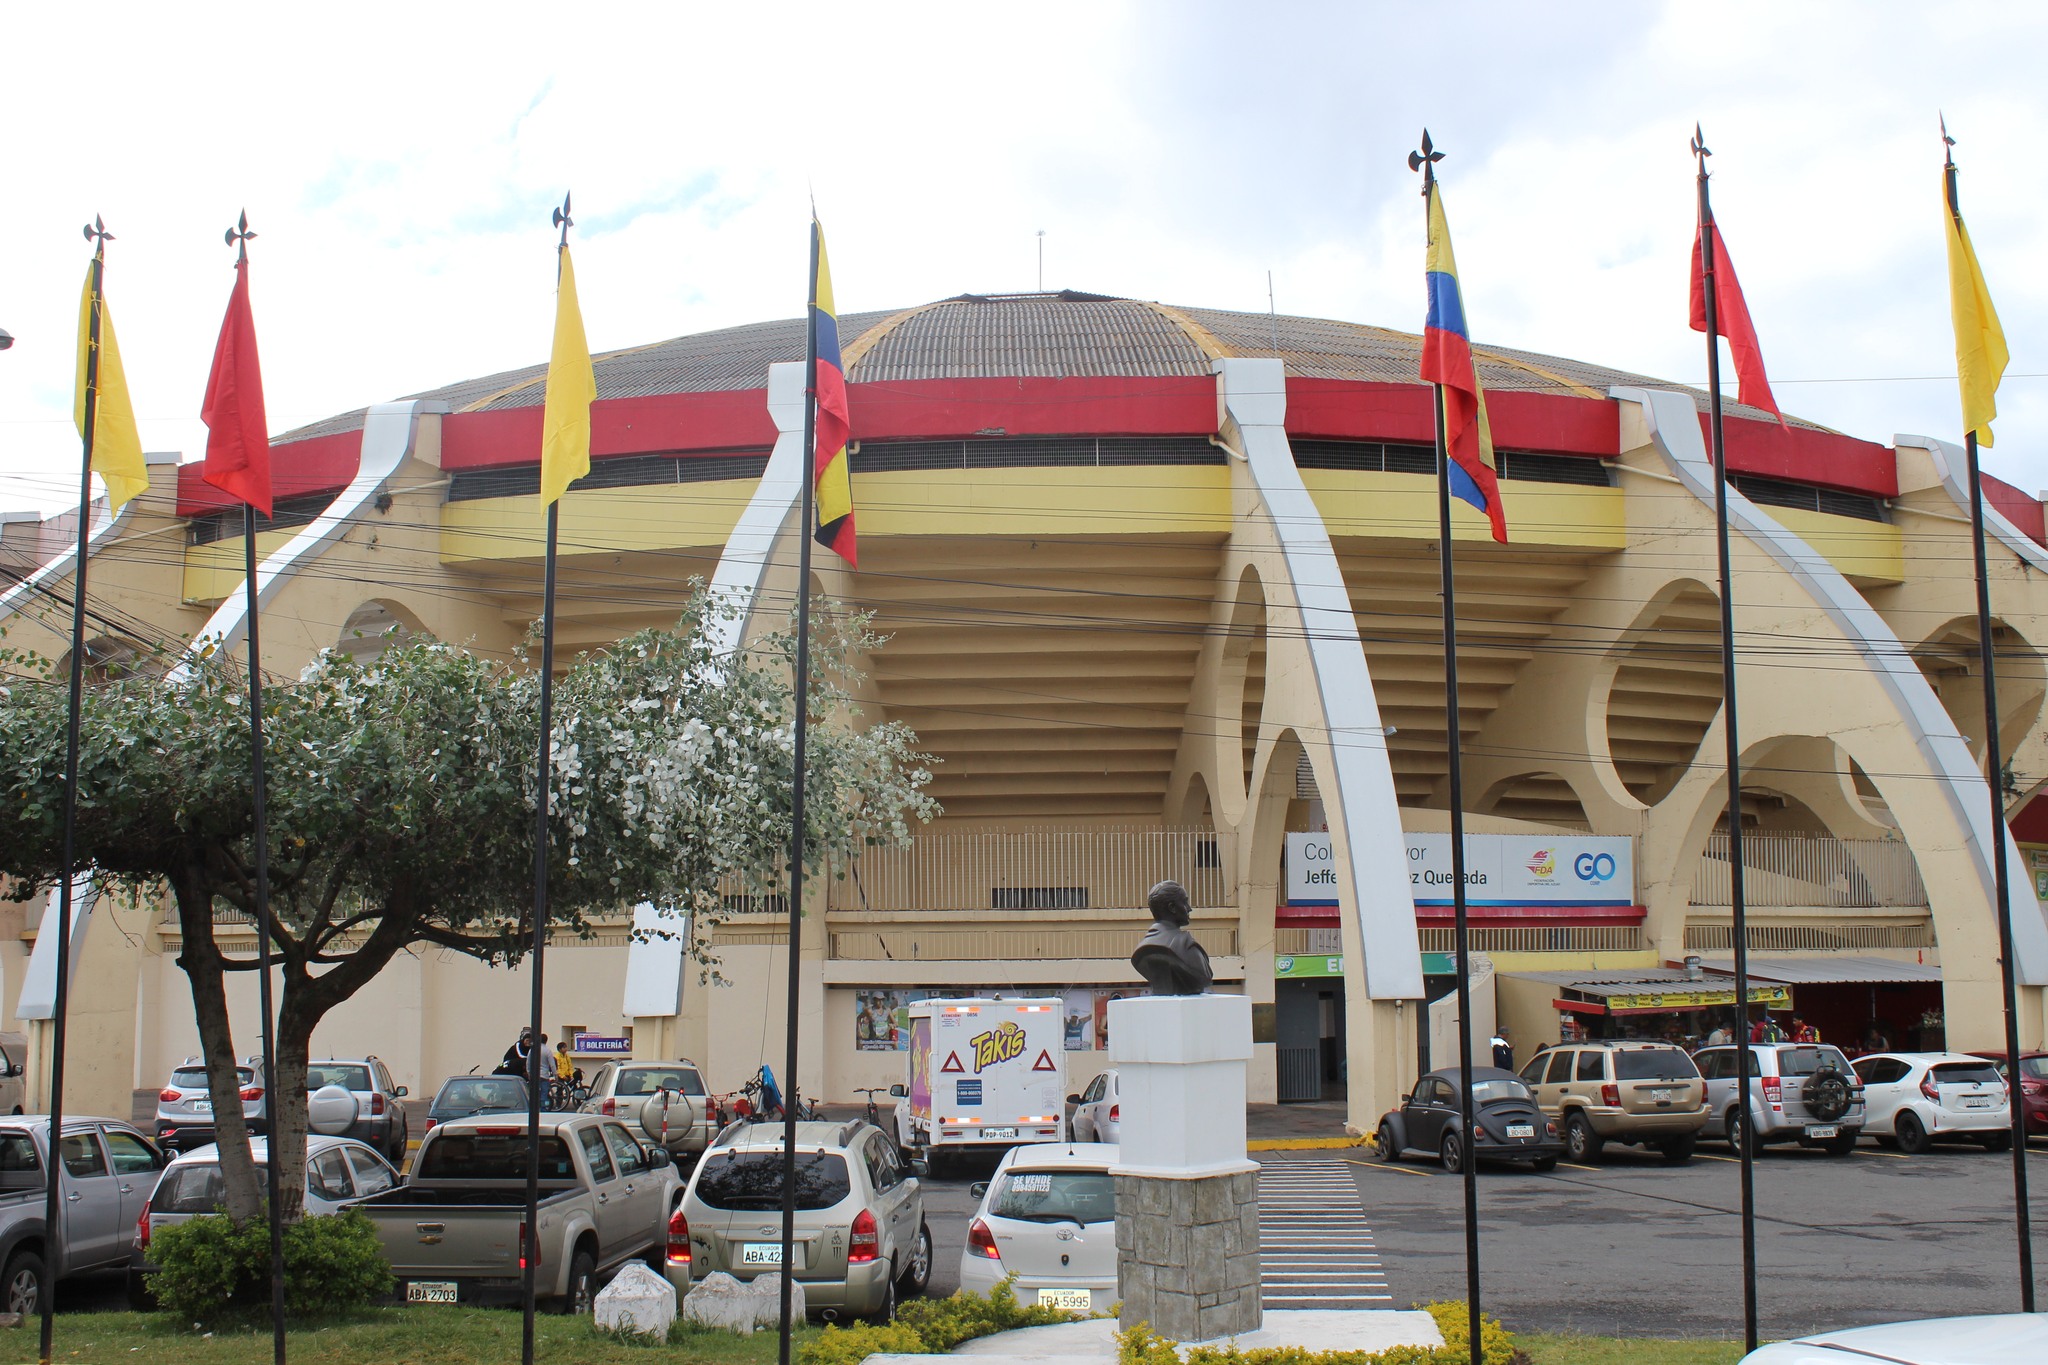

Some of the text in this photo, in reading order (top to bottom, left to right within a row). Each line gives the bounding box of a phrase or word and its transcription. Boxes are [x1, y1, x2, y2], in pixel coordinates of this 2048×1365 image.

[1304, 842, 1333, 861] Col
[1533, 866, 1553, 875] FDA
[1574, 852, 1616, 881] GO
[1304, 869, 1337, 884] Jeffe
[1424, 869, 1488, 886] Queada
[586, 1040, 623, 1049] BOLETERÍA
[970, 1027, 1026, 1075] Takis
[1013, 1174, 1052, 1185] SE VENDE
[745, 1251, 782, 1262] ABA-42
[409, 1289, 456, 1301] ABA-2703
[1040, 1296, 1089, 1307] TBA-5995
